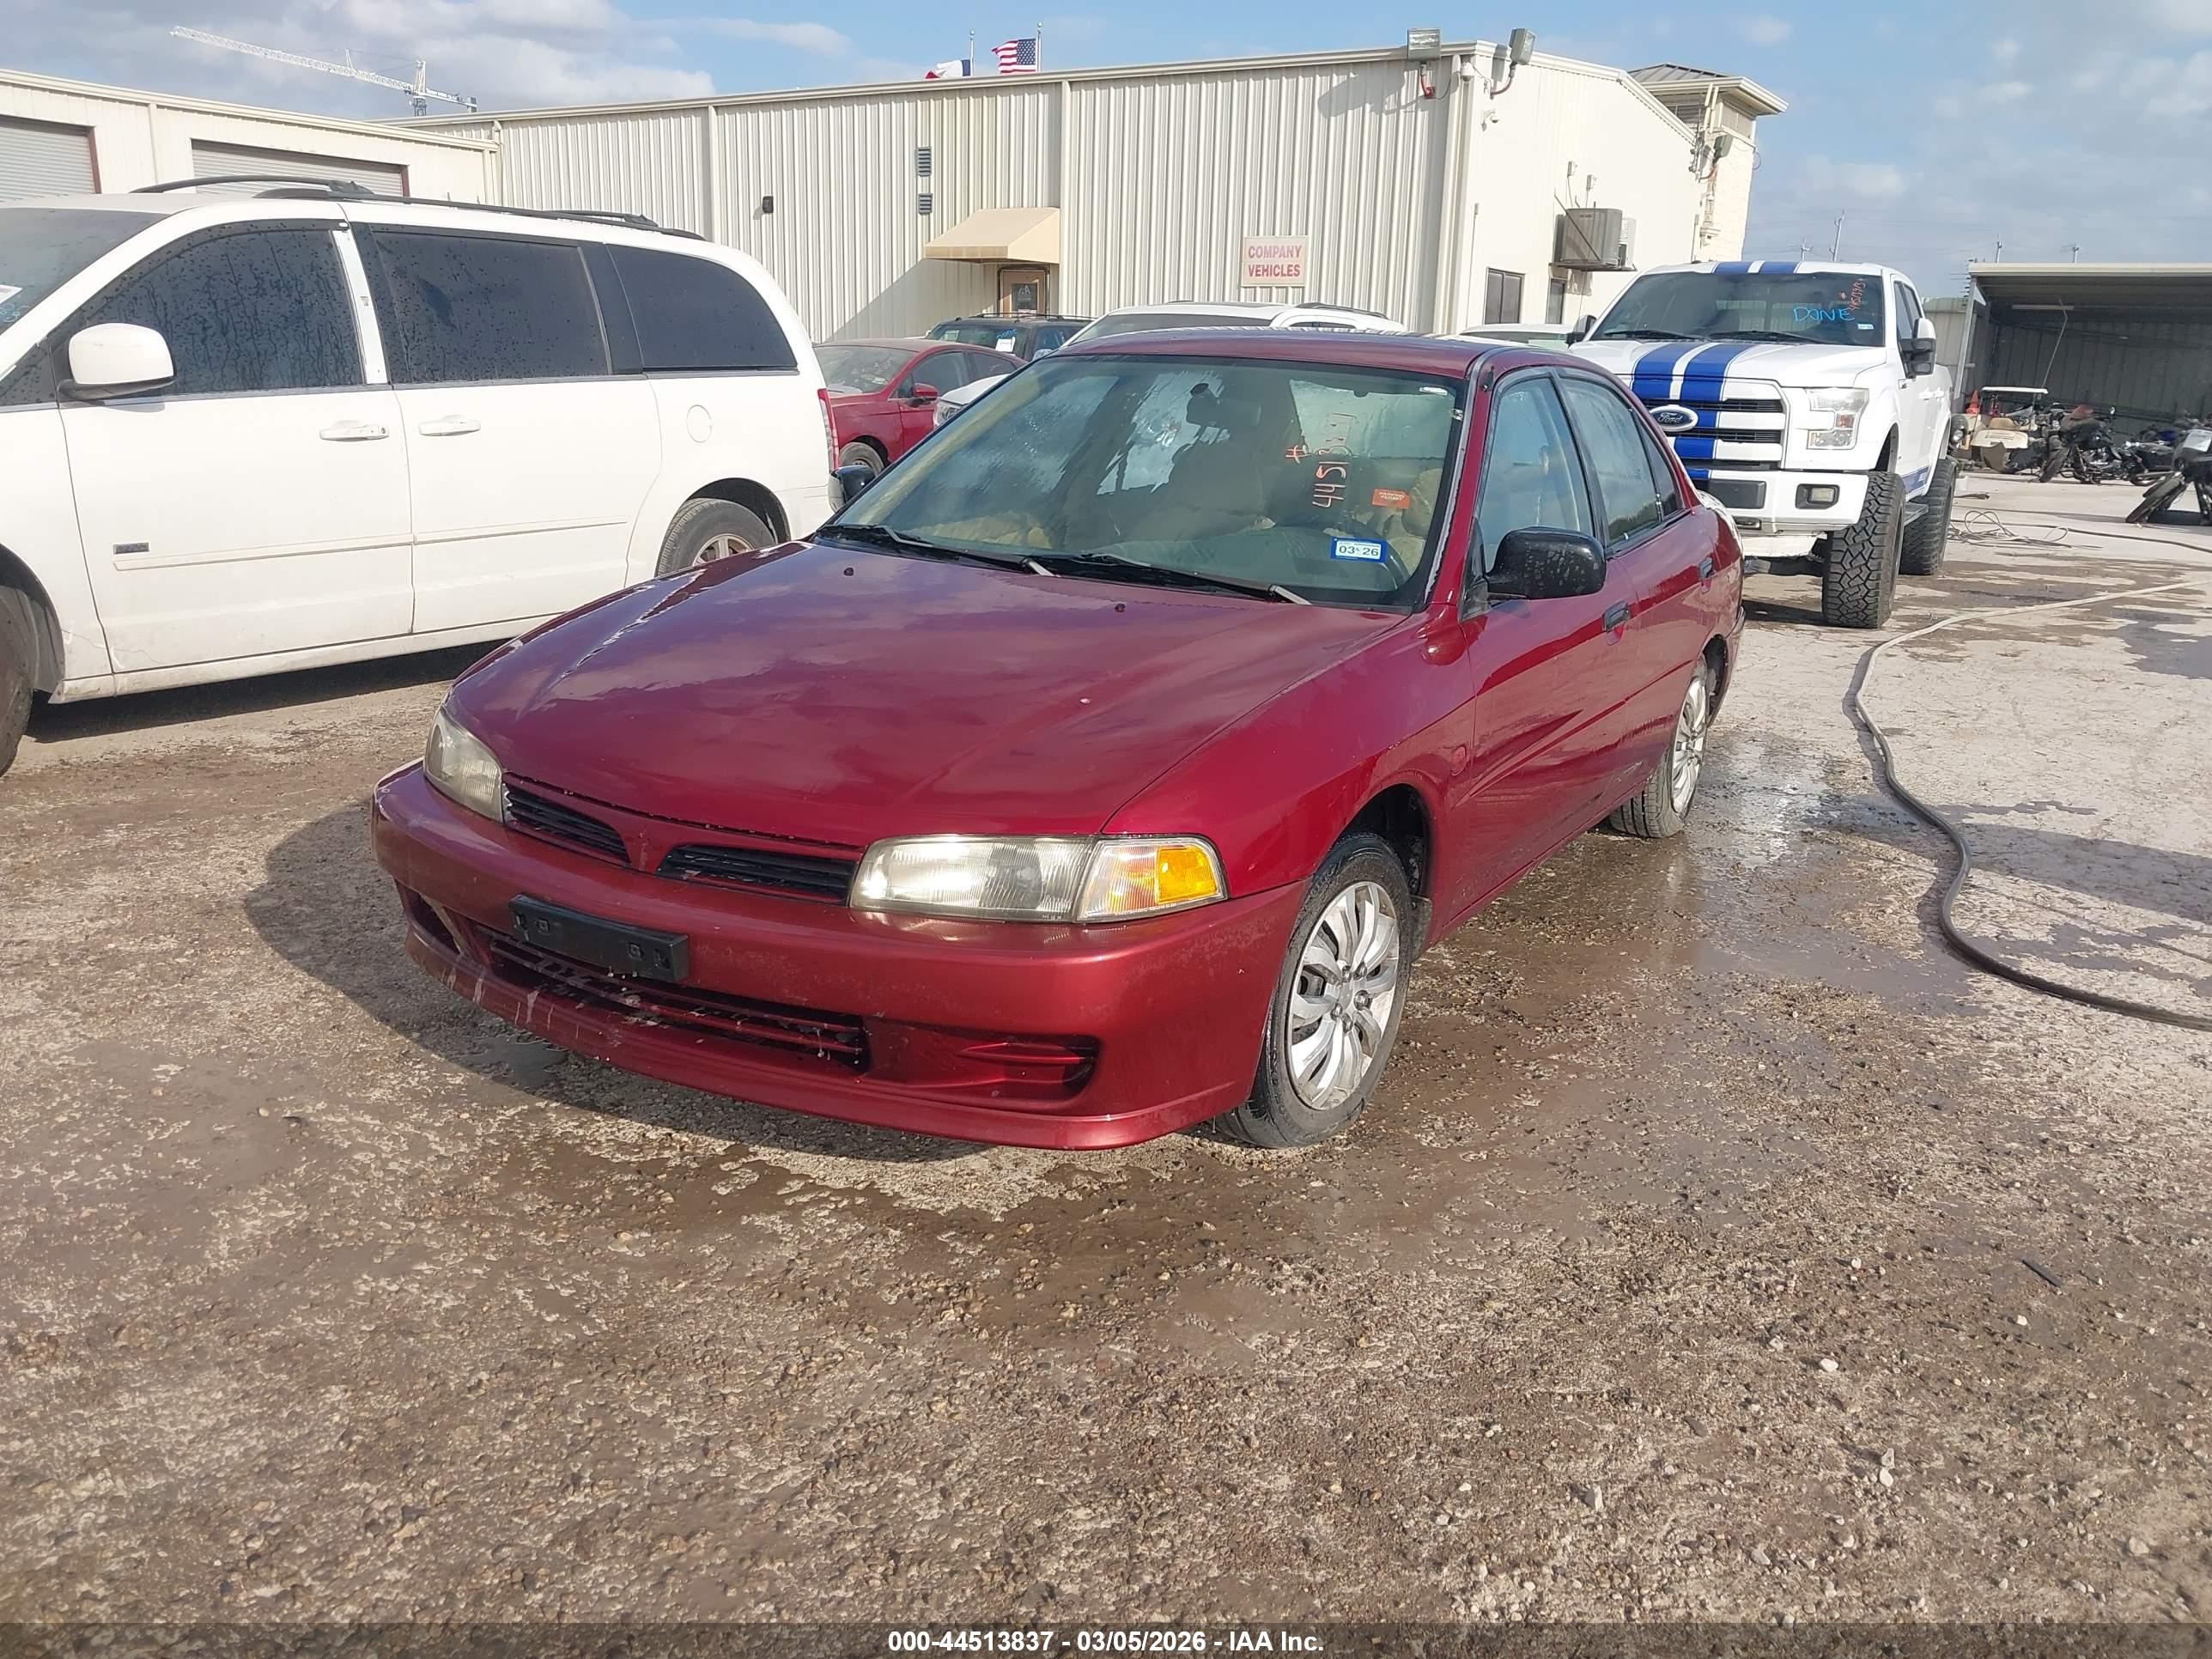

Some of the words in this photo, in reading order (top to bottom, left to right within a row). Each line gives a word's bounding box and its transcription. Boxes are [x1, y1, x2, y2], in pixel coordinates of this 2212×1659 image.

[1249, 246, 1302, 258] COMPANY
[1249, 264, 1300, 277] VEHICLES
[1793, 307, 1856, 321] DONE
[1657, 412, 1683, 423] Ford
[1285, 445, 1313, 465] #
[1312, 412, 1357, 508] 44513
[1339, 545, 1355, 555] 03
[1362, 547, 1379, 556] 26
